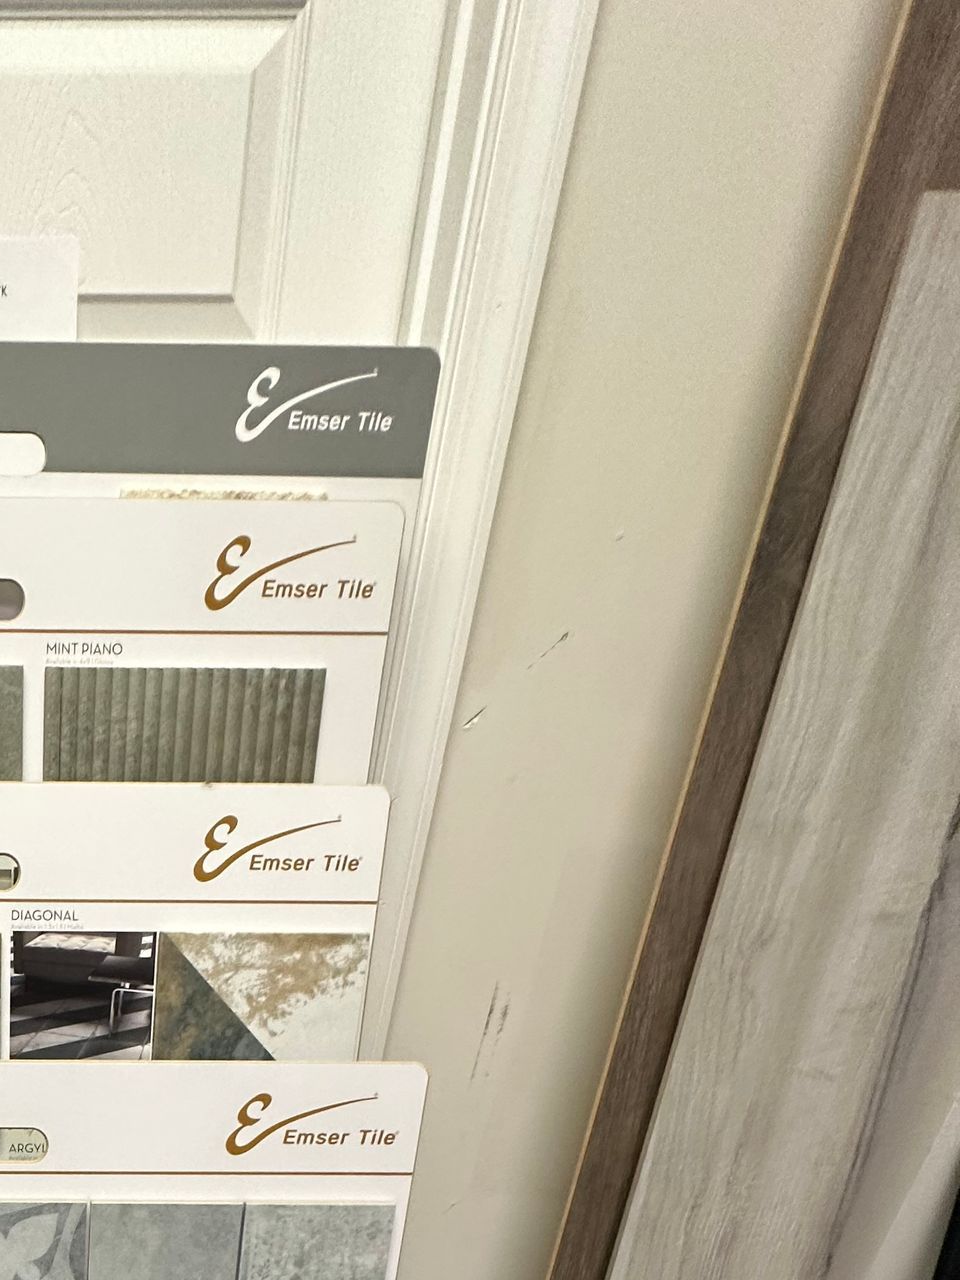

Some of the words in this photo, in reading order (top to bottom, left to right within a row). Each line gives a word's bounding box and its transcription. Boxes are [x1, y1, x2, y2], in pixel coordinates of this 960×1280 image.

[288, 410, 350, 431] Emser
[261, 580, 328, 599] Emser
[46, 643, 78, 656] MINT
[82, 643, 123, 656] PIANO
[249, 855, 314, 871] Emser
[11, 909, 79, 921] DIAGONAL
[283, 1129, 349, 1145] Emser
